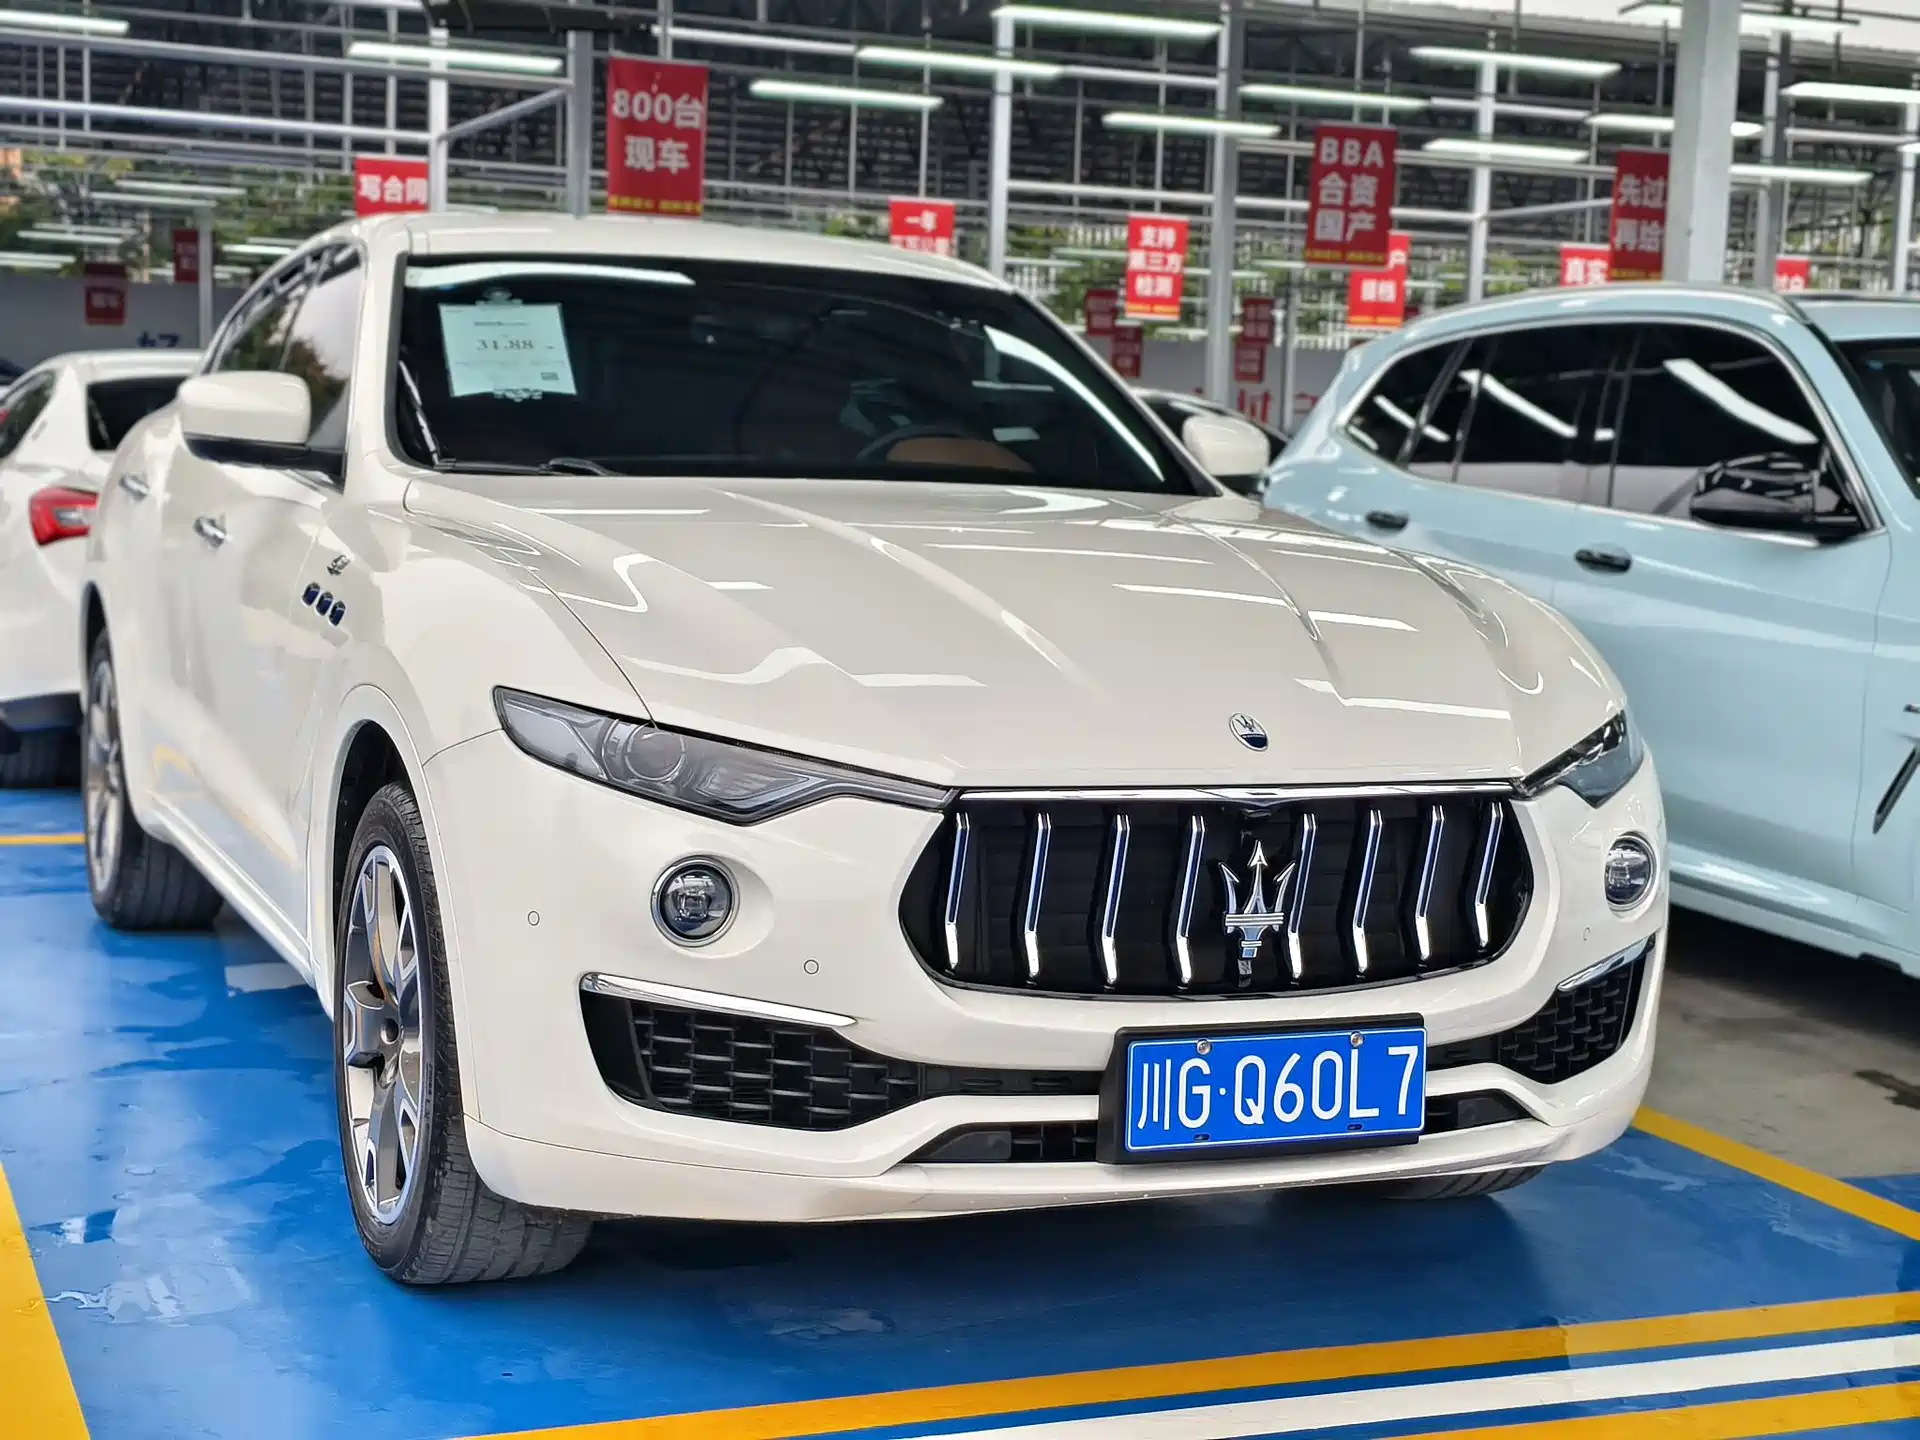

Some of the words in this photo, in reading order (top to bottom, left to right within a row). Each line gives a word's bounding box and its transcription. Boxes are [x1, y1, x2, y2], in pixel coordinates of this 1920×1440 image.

[612, 88, 703, 129] 800台
[624, 135, 690, 175] 现车
[1319, 136, 1385, 169] BBA
[1318, 171, 1379, 208] 合资
[1617, 174, 1665, 208] 先过
[1139, 225, 1178, 249] 支持
[1314, 208, 1376, 242] 国产
[1615, 218, 1662, 253] 再给
[1128, 249, 1184, 273] 第三方
[1137, 1045, 1420, 1131] 川G·Q60L7
